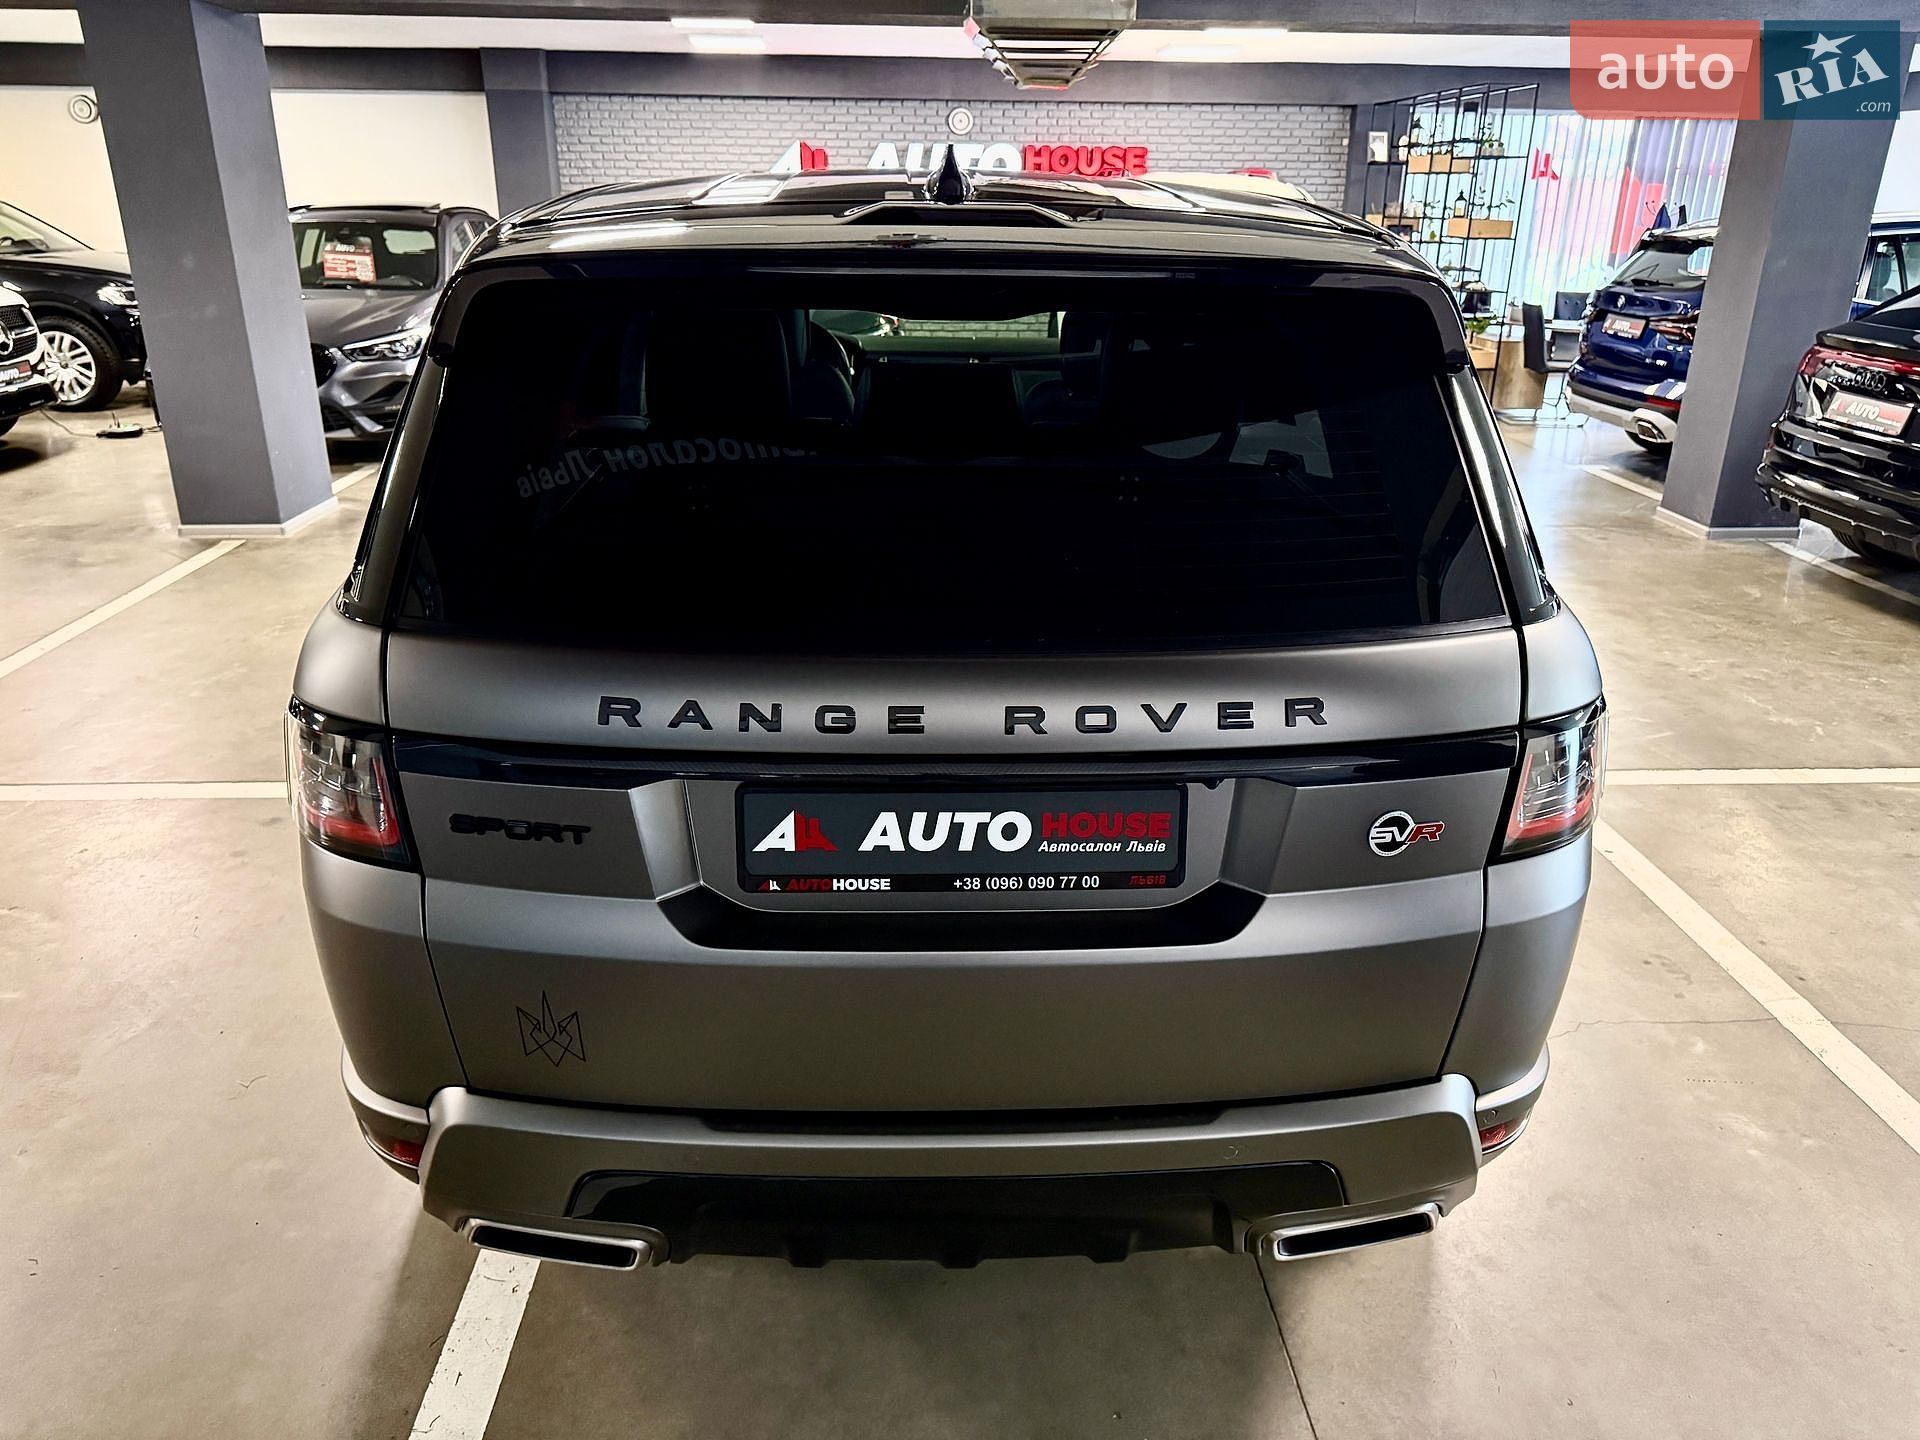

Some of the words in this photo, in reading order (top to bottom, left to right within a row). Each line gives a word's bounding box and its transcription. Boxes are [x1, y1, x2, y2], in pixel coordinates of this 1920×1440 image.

[1024, 144, 1150, 176] HOUSE
[1845, 401, 1880, 420] AUTO
[597, 696, 925, 735] RANGE
[1004, 697, 1328, 735] ROVER
[449, 813, 592, 845] SPORT
[858, 811, 1033, 852] AUTO
[1042, 812, 1172, 839] HOUSE
[1369, 815, 1445, 850] SVR
[1038, 840, 1121, 853] Автосалон
[1126, 840, 1167, 852] Львів
[953, 876, 981, 890] +38
[985, 876, 1023, 890] (096)
[1028, 876, 1055, 889] 090
[1059, 875, 1078, 889] 77
[1082, 875, 1100, 888] 00
